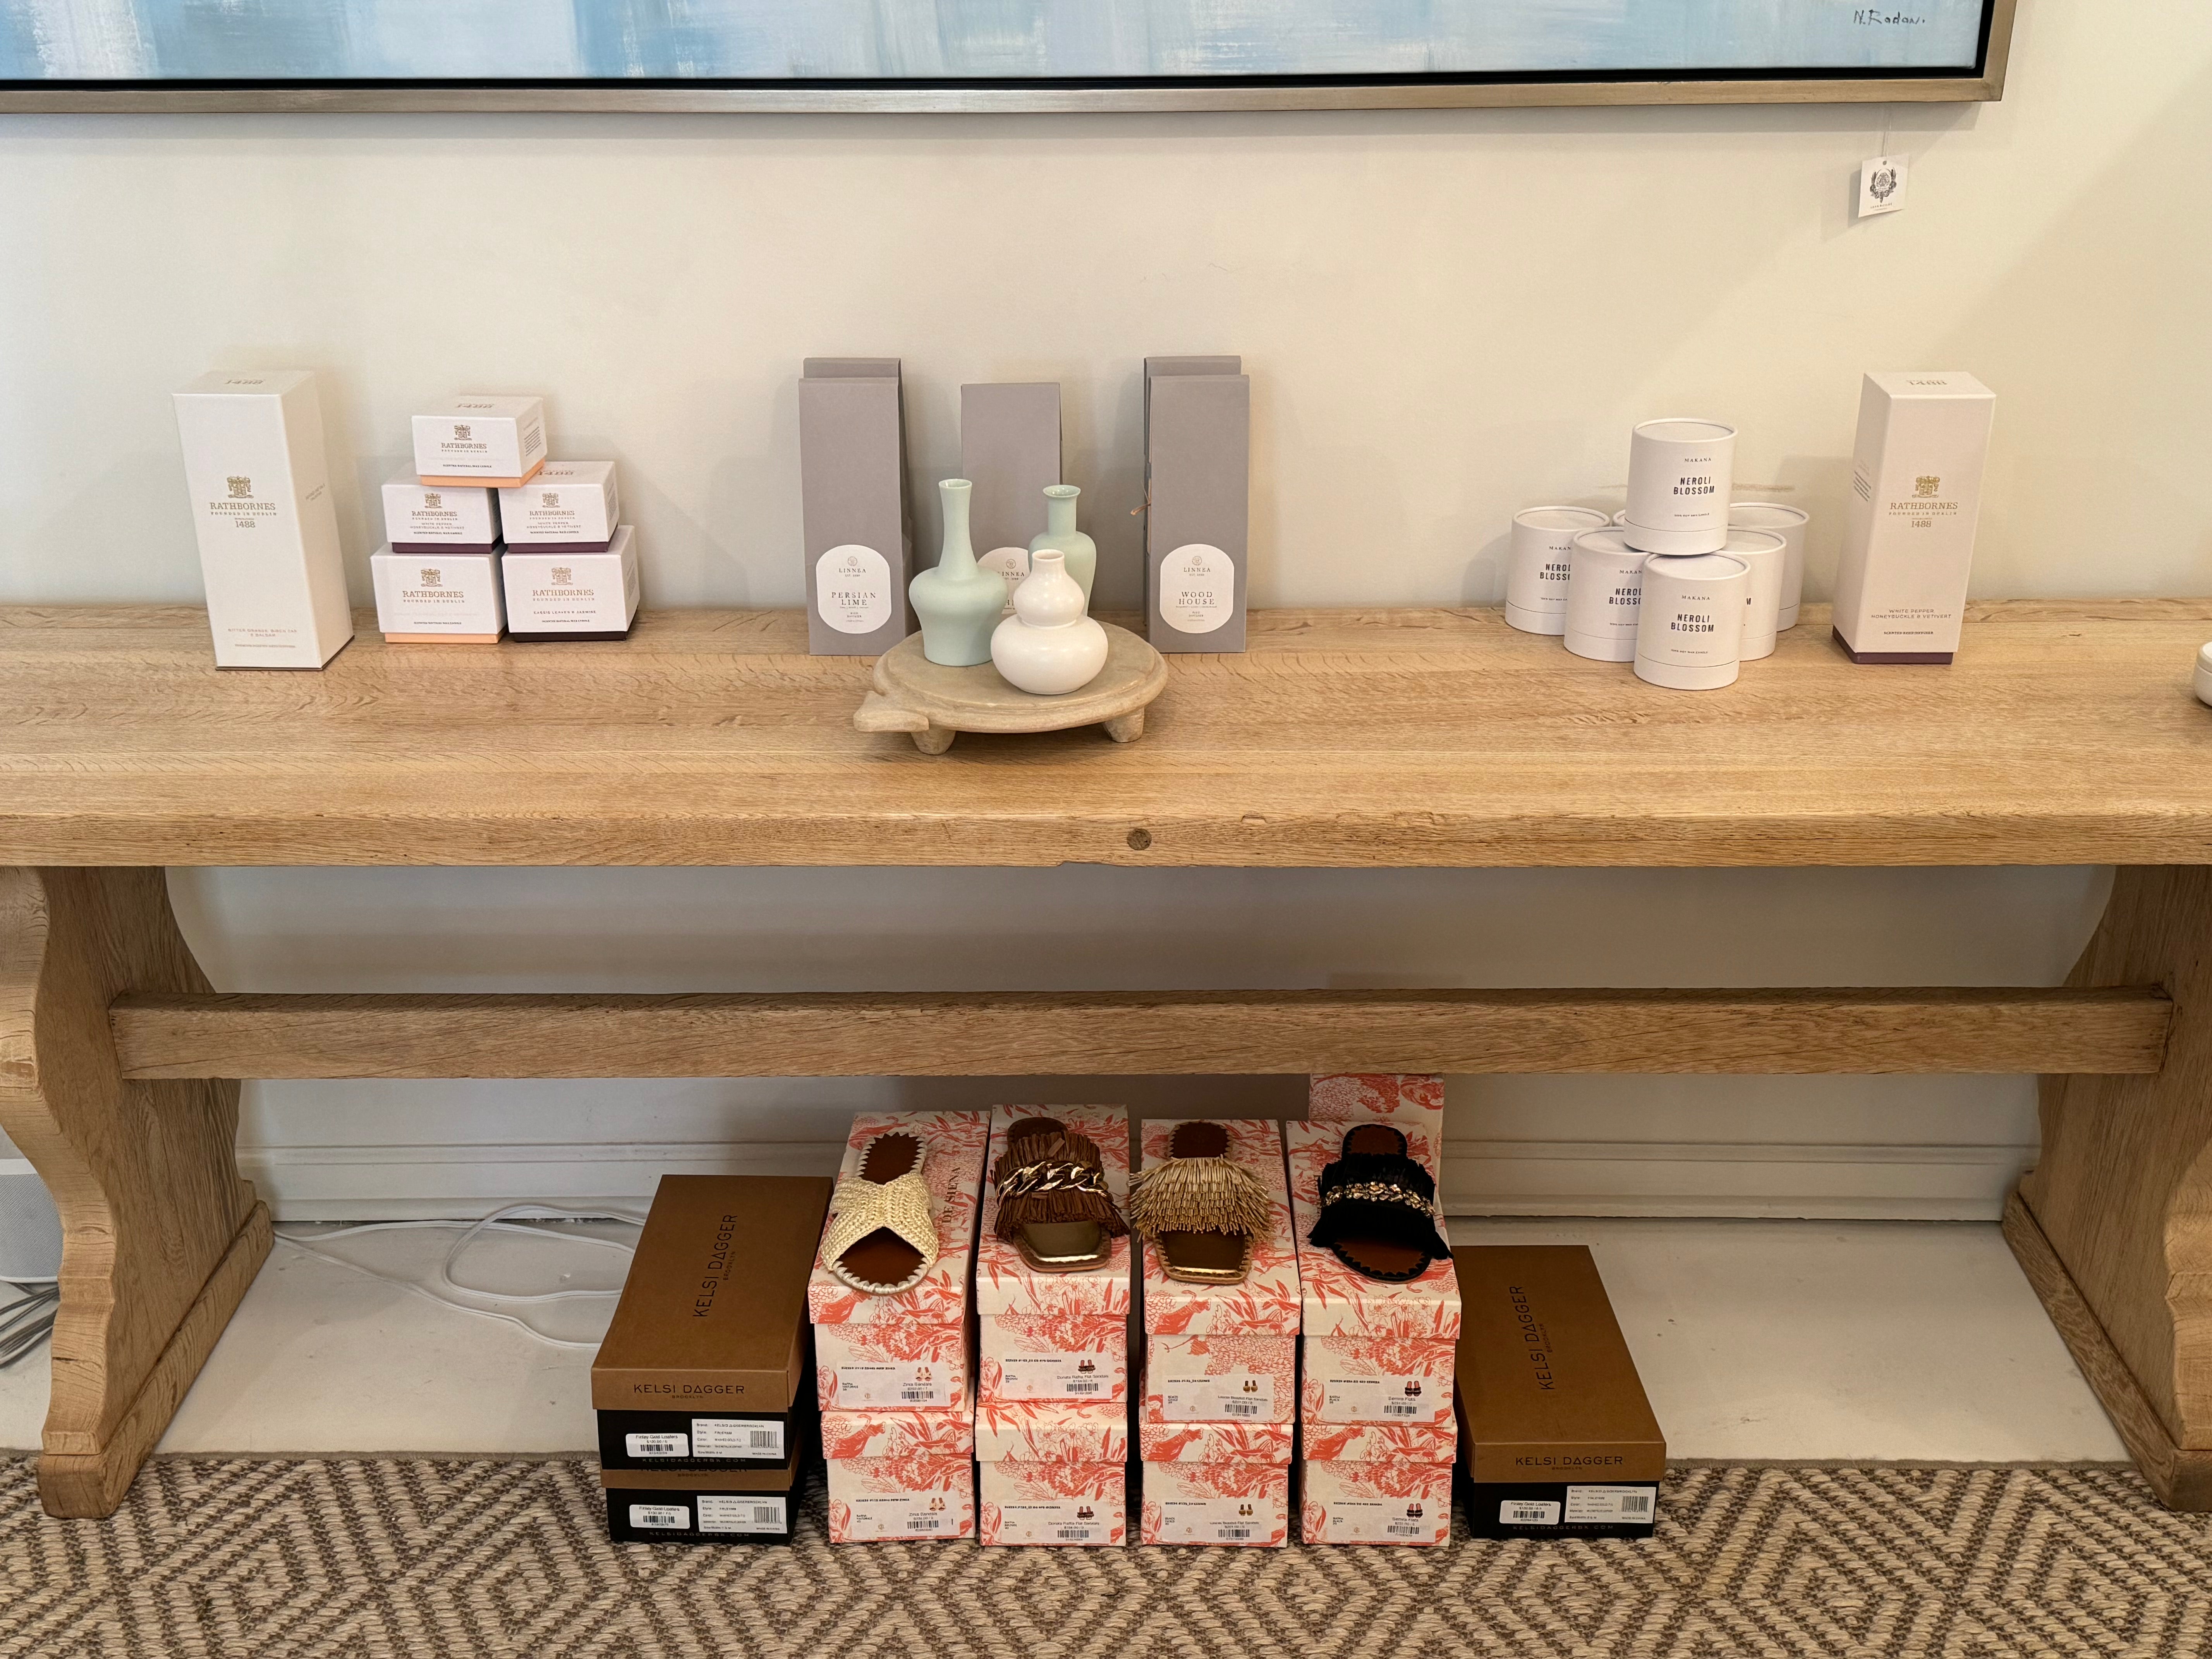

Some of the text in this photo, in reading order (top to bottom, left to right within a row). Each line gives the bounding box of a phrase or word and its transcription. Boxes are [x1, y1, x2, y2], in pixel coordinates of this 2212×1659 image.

[1680, 476, 1711, 485] NEROLI
[1673, 486, 1714, 495] BLOSSOM
[210, 502, 276, 510] RATHBORNES
[1540, 572, 1570, 580] BLOSS
[1609, 597, 1641, 605] BLOSS
[1678, 614, 1710, 623] NEROLI
[1671, 622, 1714, 632] BLOSSOM
[942, 1167, 961, 1223] DE SIENA
[693, 1215, 737, 1317] KELSI DAGGER
[723, 1251, 735, 1281] BROOKLYN
[1509, 1286, 1555, 1389] KELSI DAGGER
[1539, 1323, 1553, 1353] BROOKLYN
[634, 1384, 744, 1394] KELSI DAGGER
[1516, 1456, 1623, 1465] KELSI DAGGER
